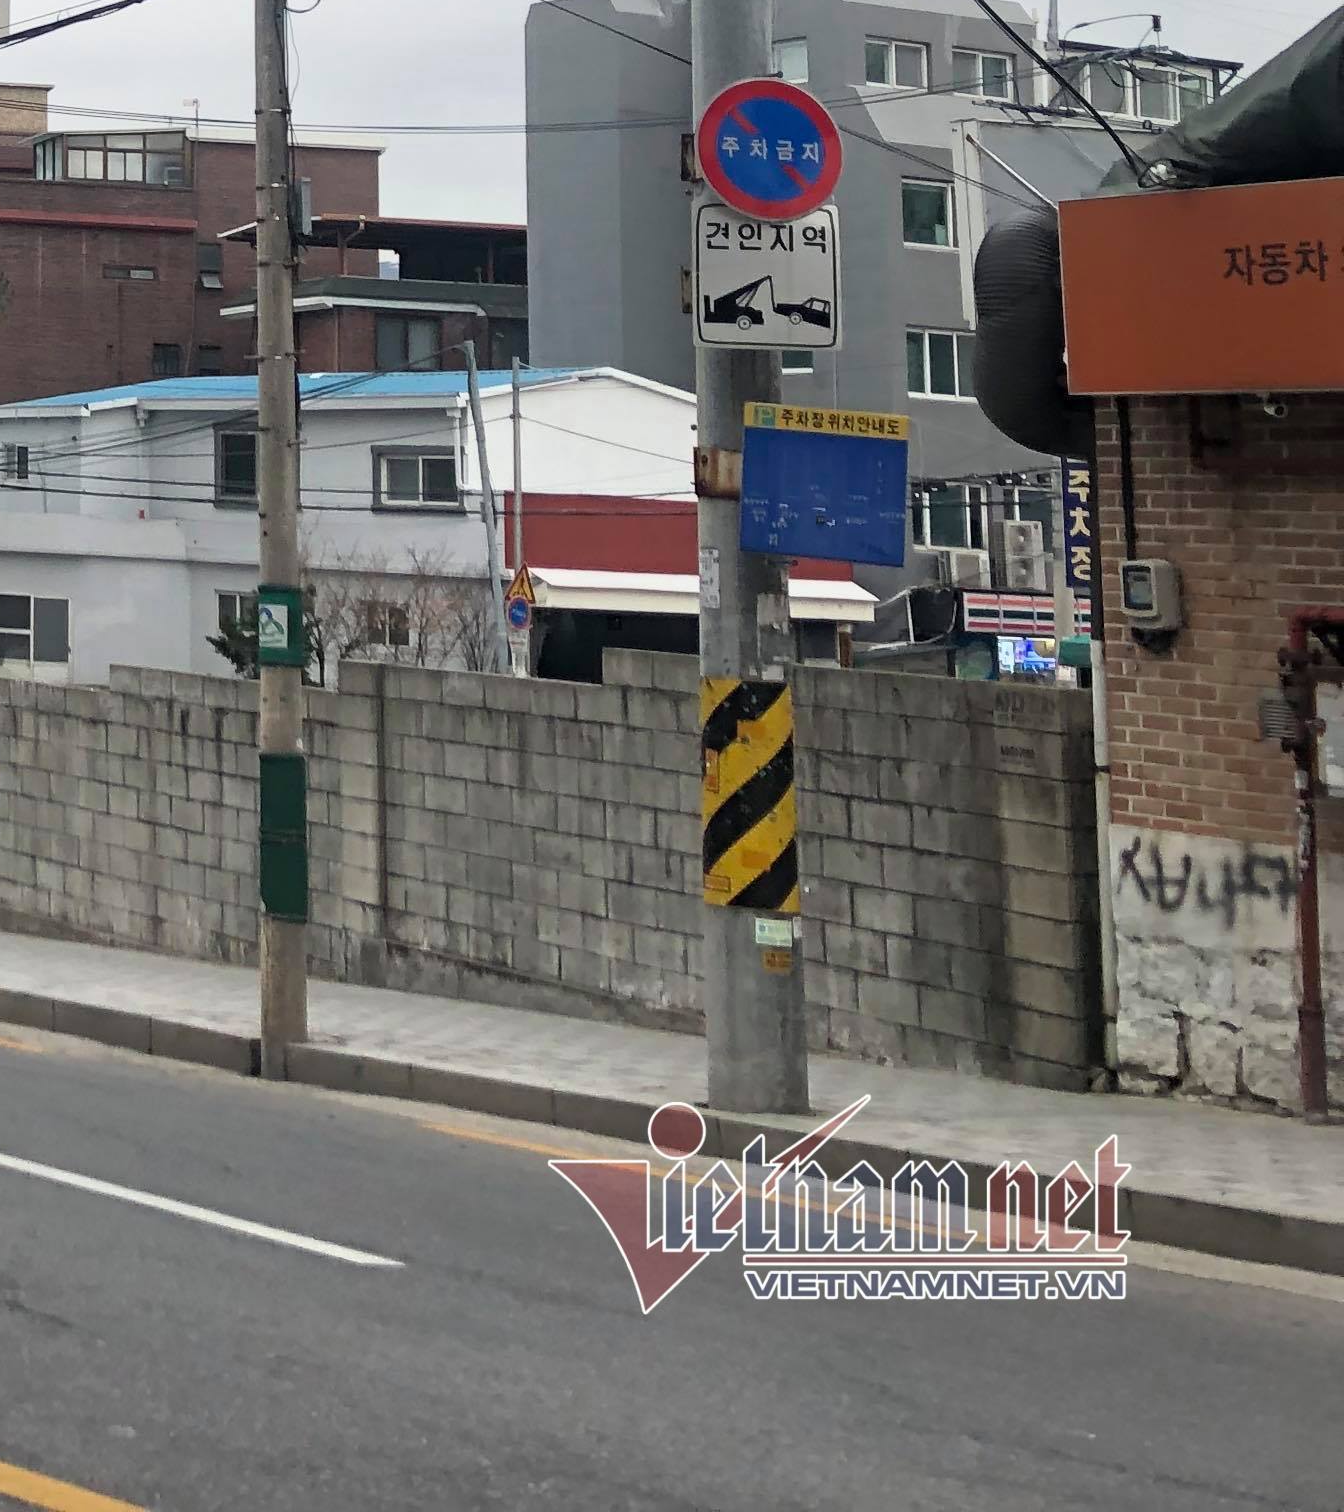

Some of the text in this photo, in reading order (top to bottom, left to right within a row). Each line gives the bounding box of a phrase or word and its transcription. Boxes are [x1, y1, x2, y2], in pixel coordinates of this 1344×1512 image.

[721, 136, 819, 164] 주차금지
[705, 222, 827, 254] 견인지역
[1223, 240, 1329, 286] 자동차
